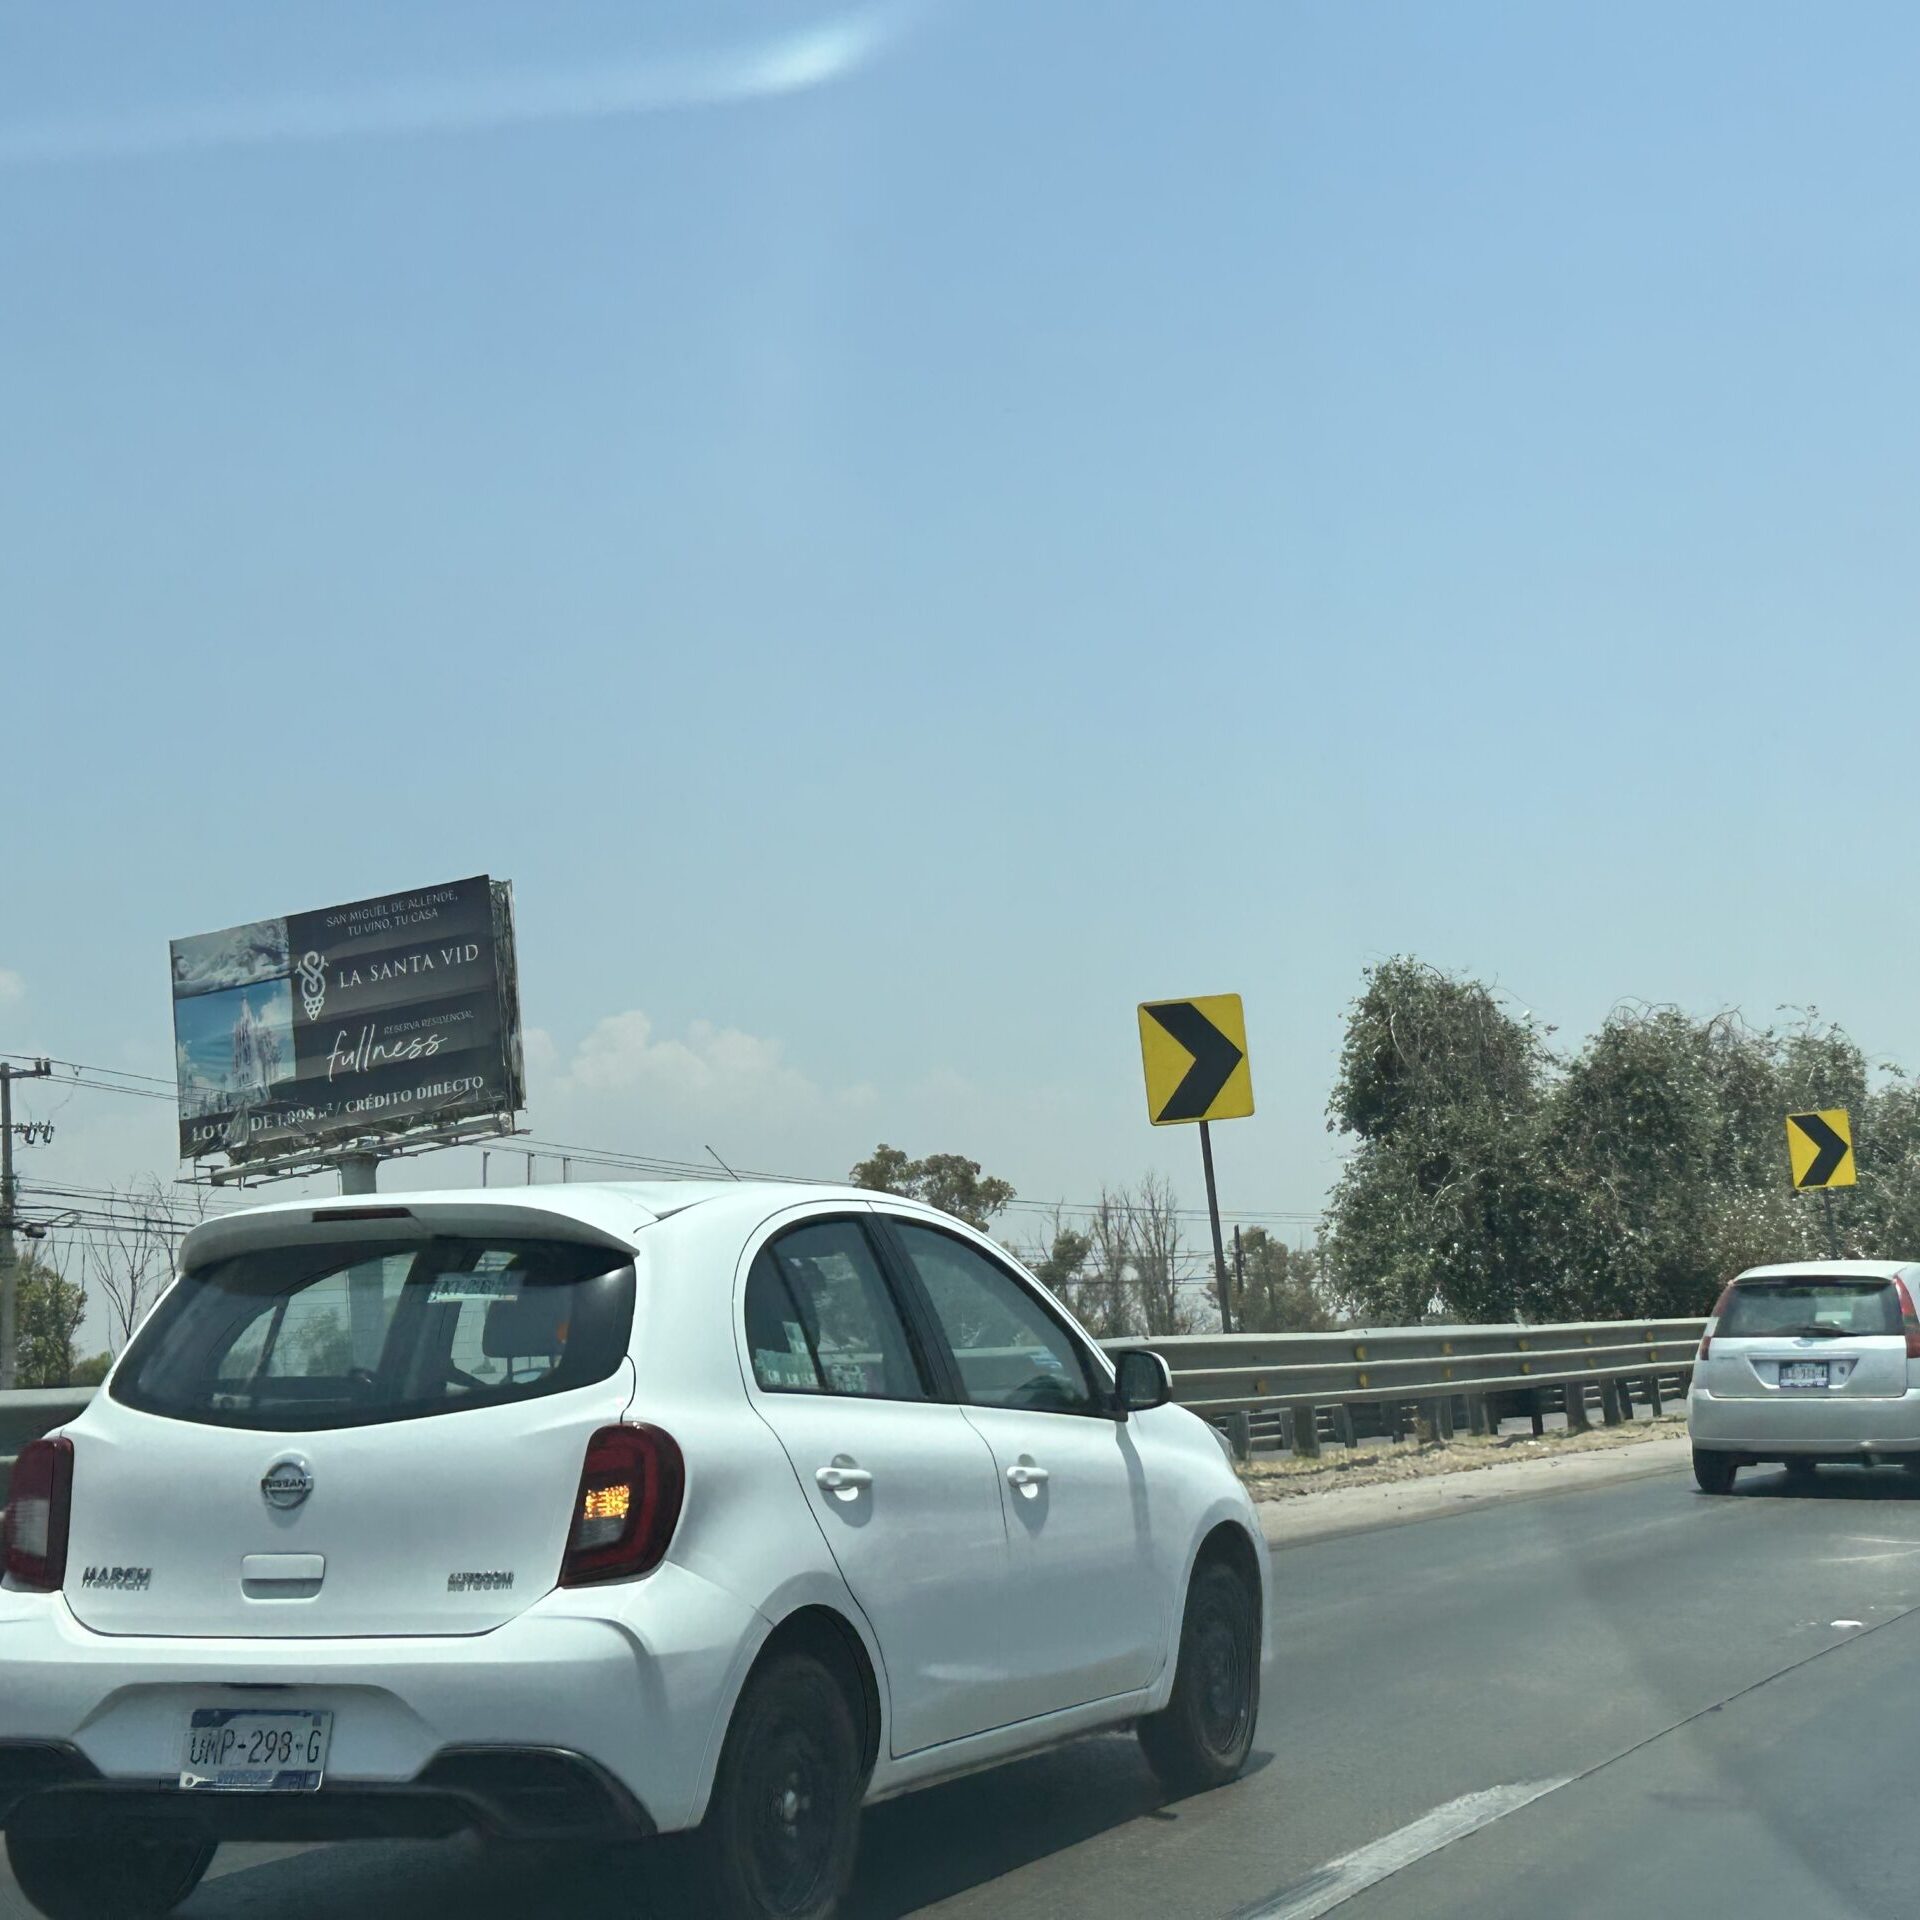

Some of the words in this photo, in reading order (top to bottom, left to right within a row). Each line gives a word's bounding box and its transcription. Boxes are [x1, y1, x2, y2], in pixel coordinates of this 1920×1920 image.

[326, 912, 349, 928] SAN
[349, 904, 389, 921] MIGUEL
[391, 901, 405, 914] DE
[347, 924, 362, 937] TU
[364, 918, 393, 932] VINO,
[395, 913, 409, 926] TU
[410, 907, 439, 923] CASA
[339, 969, 363, 989] LA
[370, 953, 435, 982] SANTA
[441, 943, 480, 966] VID
[326, 1023, 449, 1082] fullness
[250, 1114, 274, 1132] DE
[345, 1089, 413, 1113] CRÉDITO
[416, 1075, 484, 1099] DIRECTO
